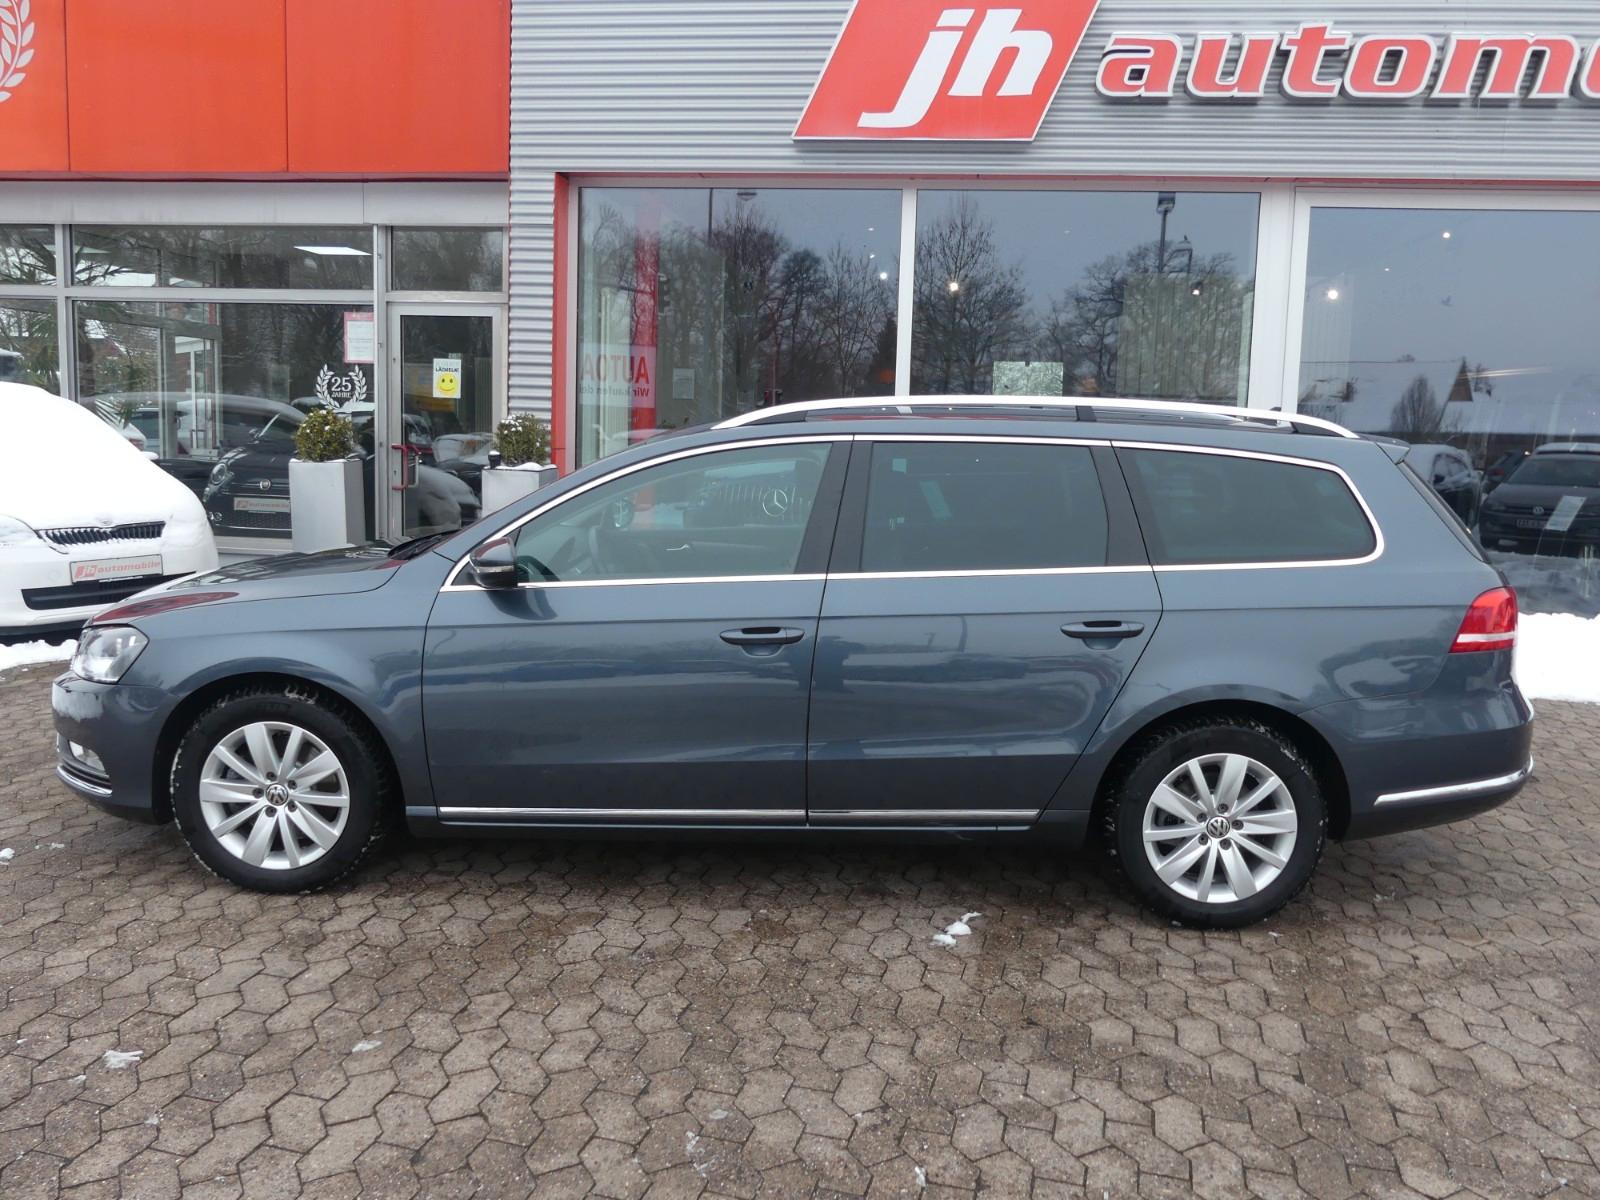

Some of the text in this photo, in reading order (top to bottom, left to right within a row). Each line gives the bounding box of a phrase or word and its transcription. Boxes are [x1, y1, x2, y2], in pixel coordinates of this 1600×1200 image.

[857, 8, 1600, 128] jh autom
[331, 377, 352, 391] 25
